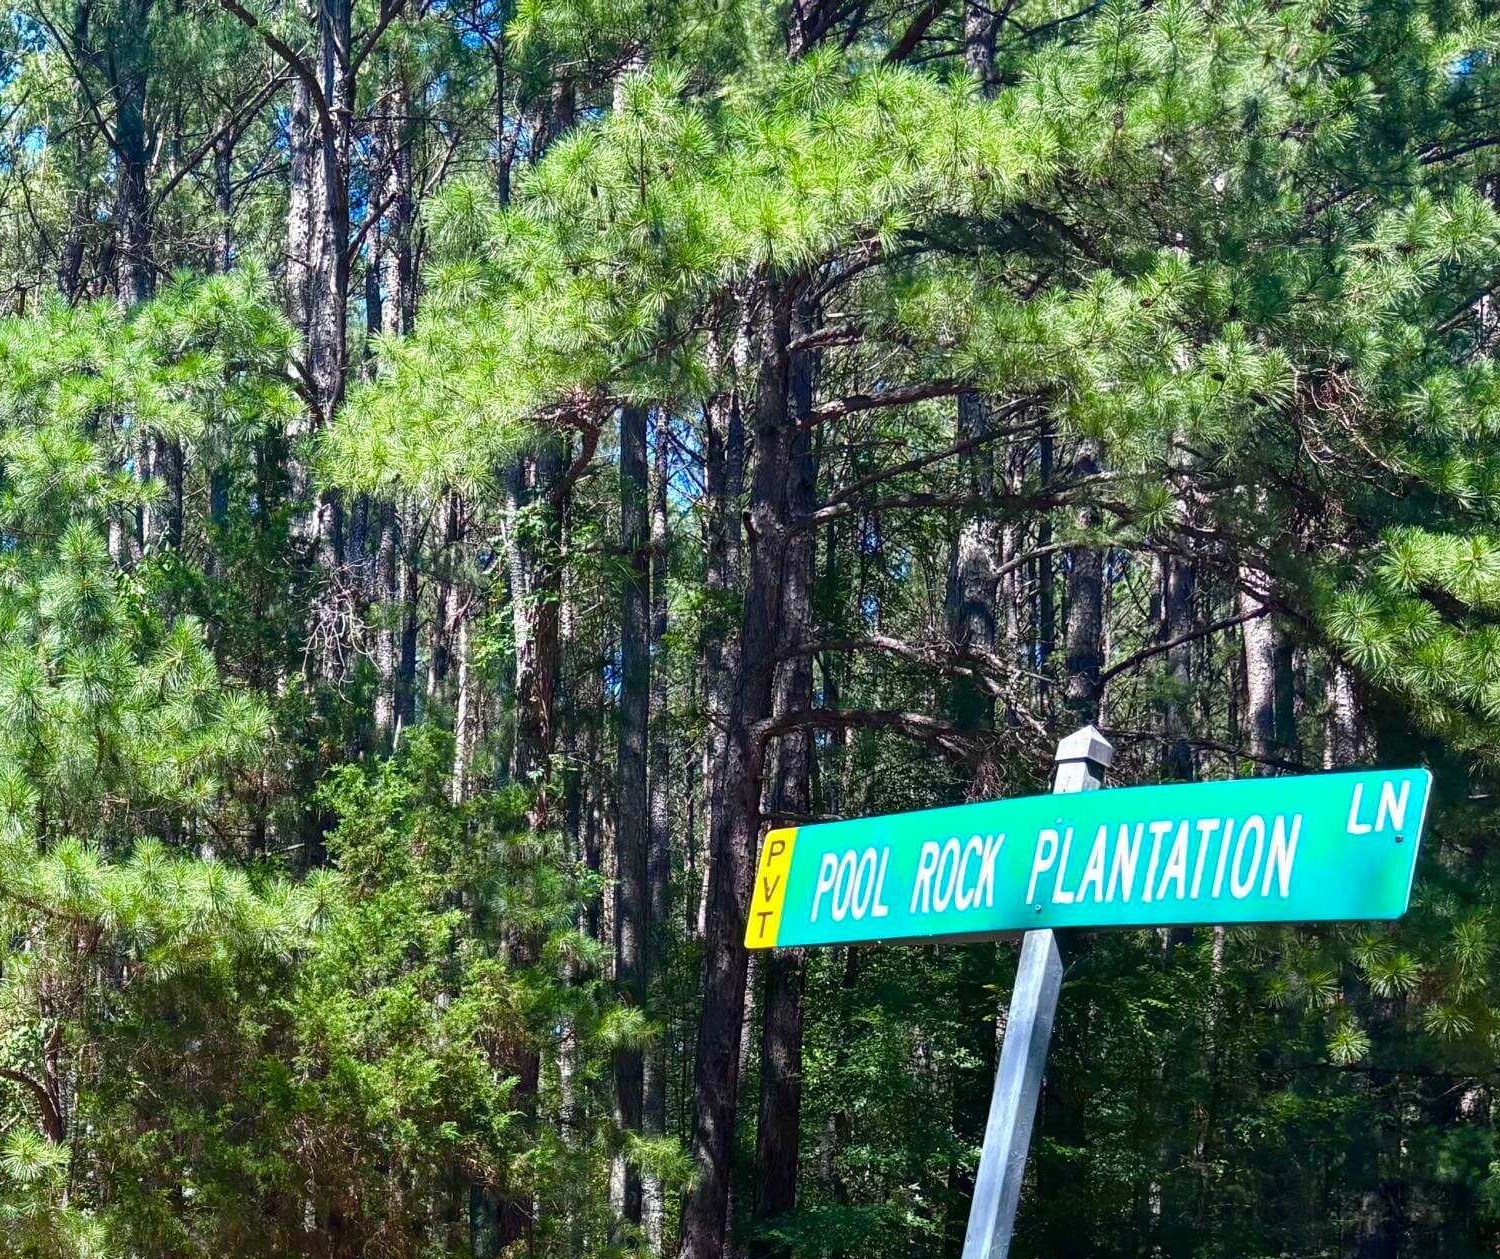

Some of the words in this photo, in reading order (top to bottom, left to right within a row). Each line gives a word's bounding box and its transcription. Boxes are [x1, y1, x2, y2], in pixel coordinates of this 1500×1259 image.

[754, 839, 787, 940] PVT
[810, 846, 890, 923] POOL
[909, 832, 1008, 915] ROCK
[1025, 813, 1303, 906] PLANTATION
[1346, 778, 1411, 835] LN
